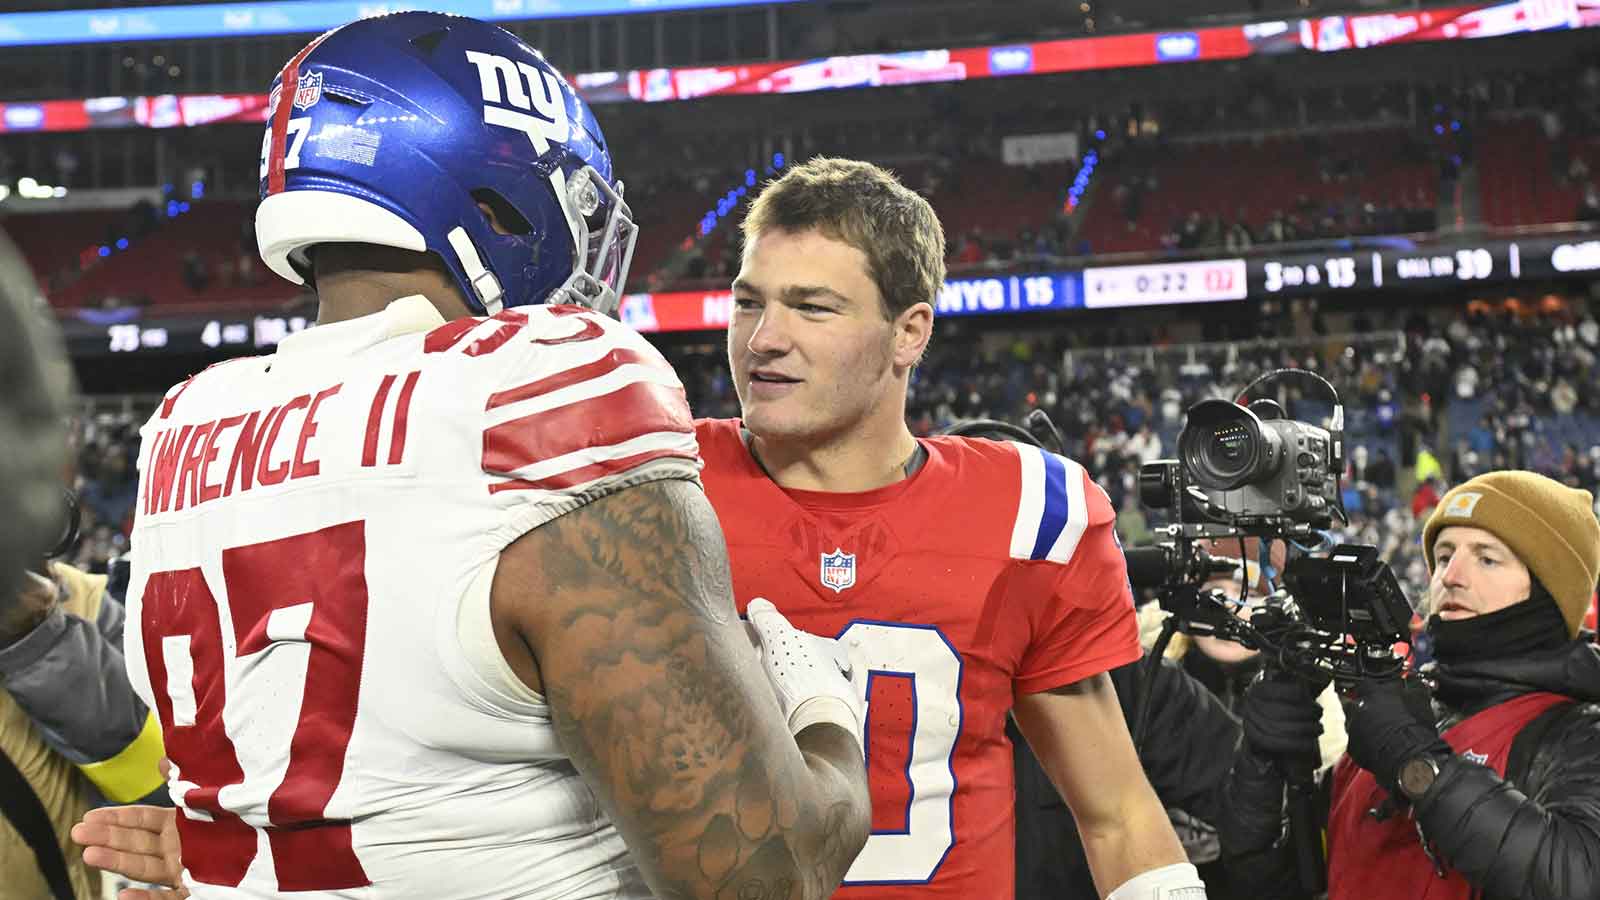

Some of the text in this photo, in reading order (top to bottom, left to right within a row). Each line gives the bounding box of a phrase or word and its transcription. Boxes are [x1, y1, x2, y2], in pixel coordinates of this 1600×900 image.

[936, 276, 1054, 313] NYG 15
[1136, 272, 1188, 293] 0:22
[361, 370, 422, 467] II
[141, 519, 374, 892] 97
